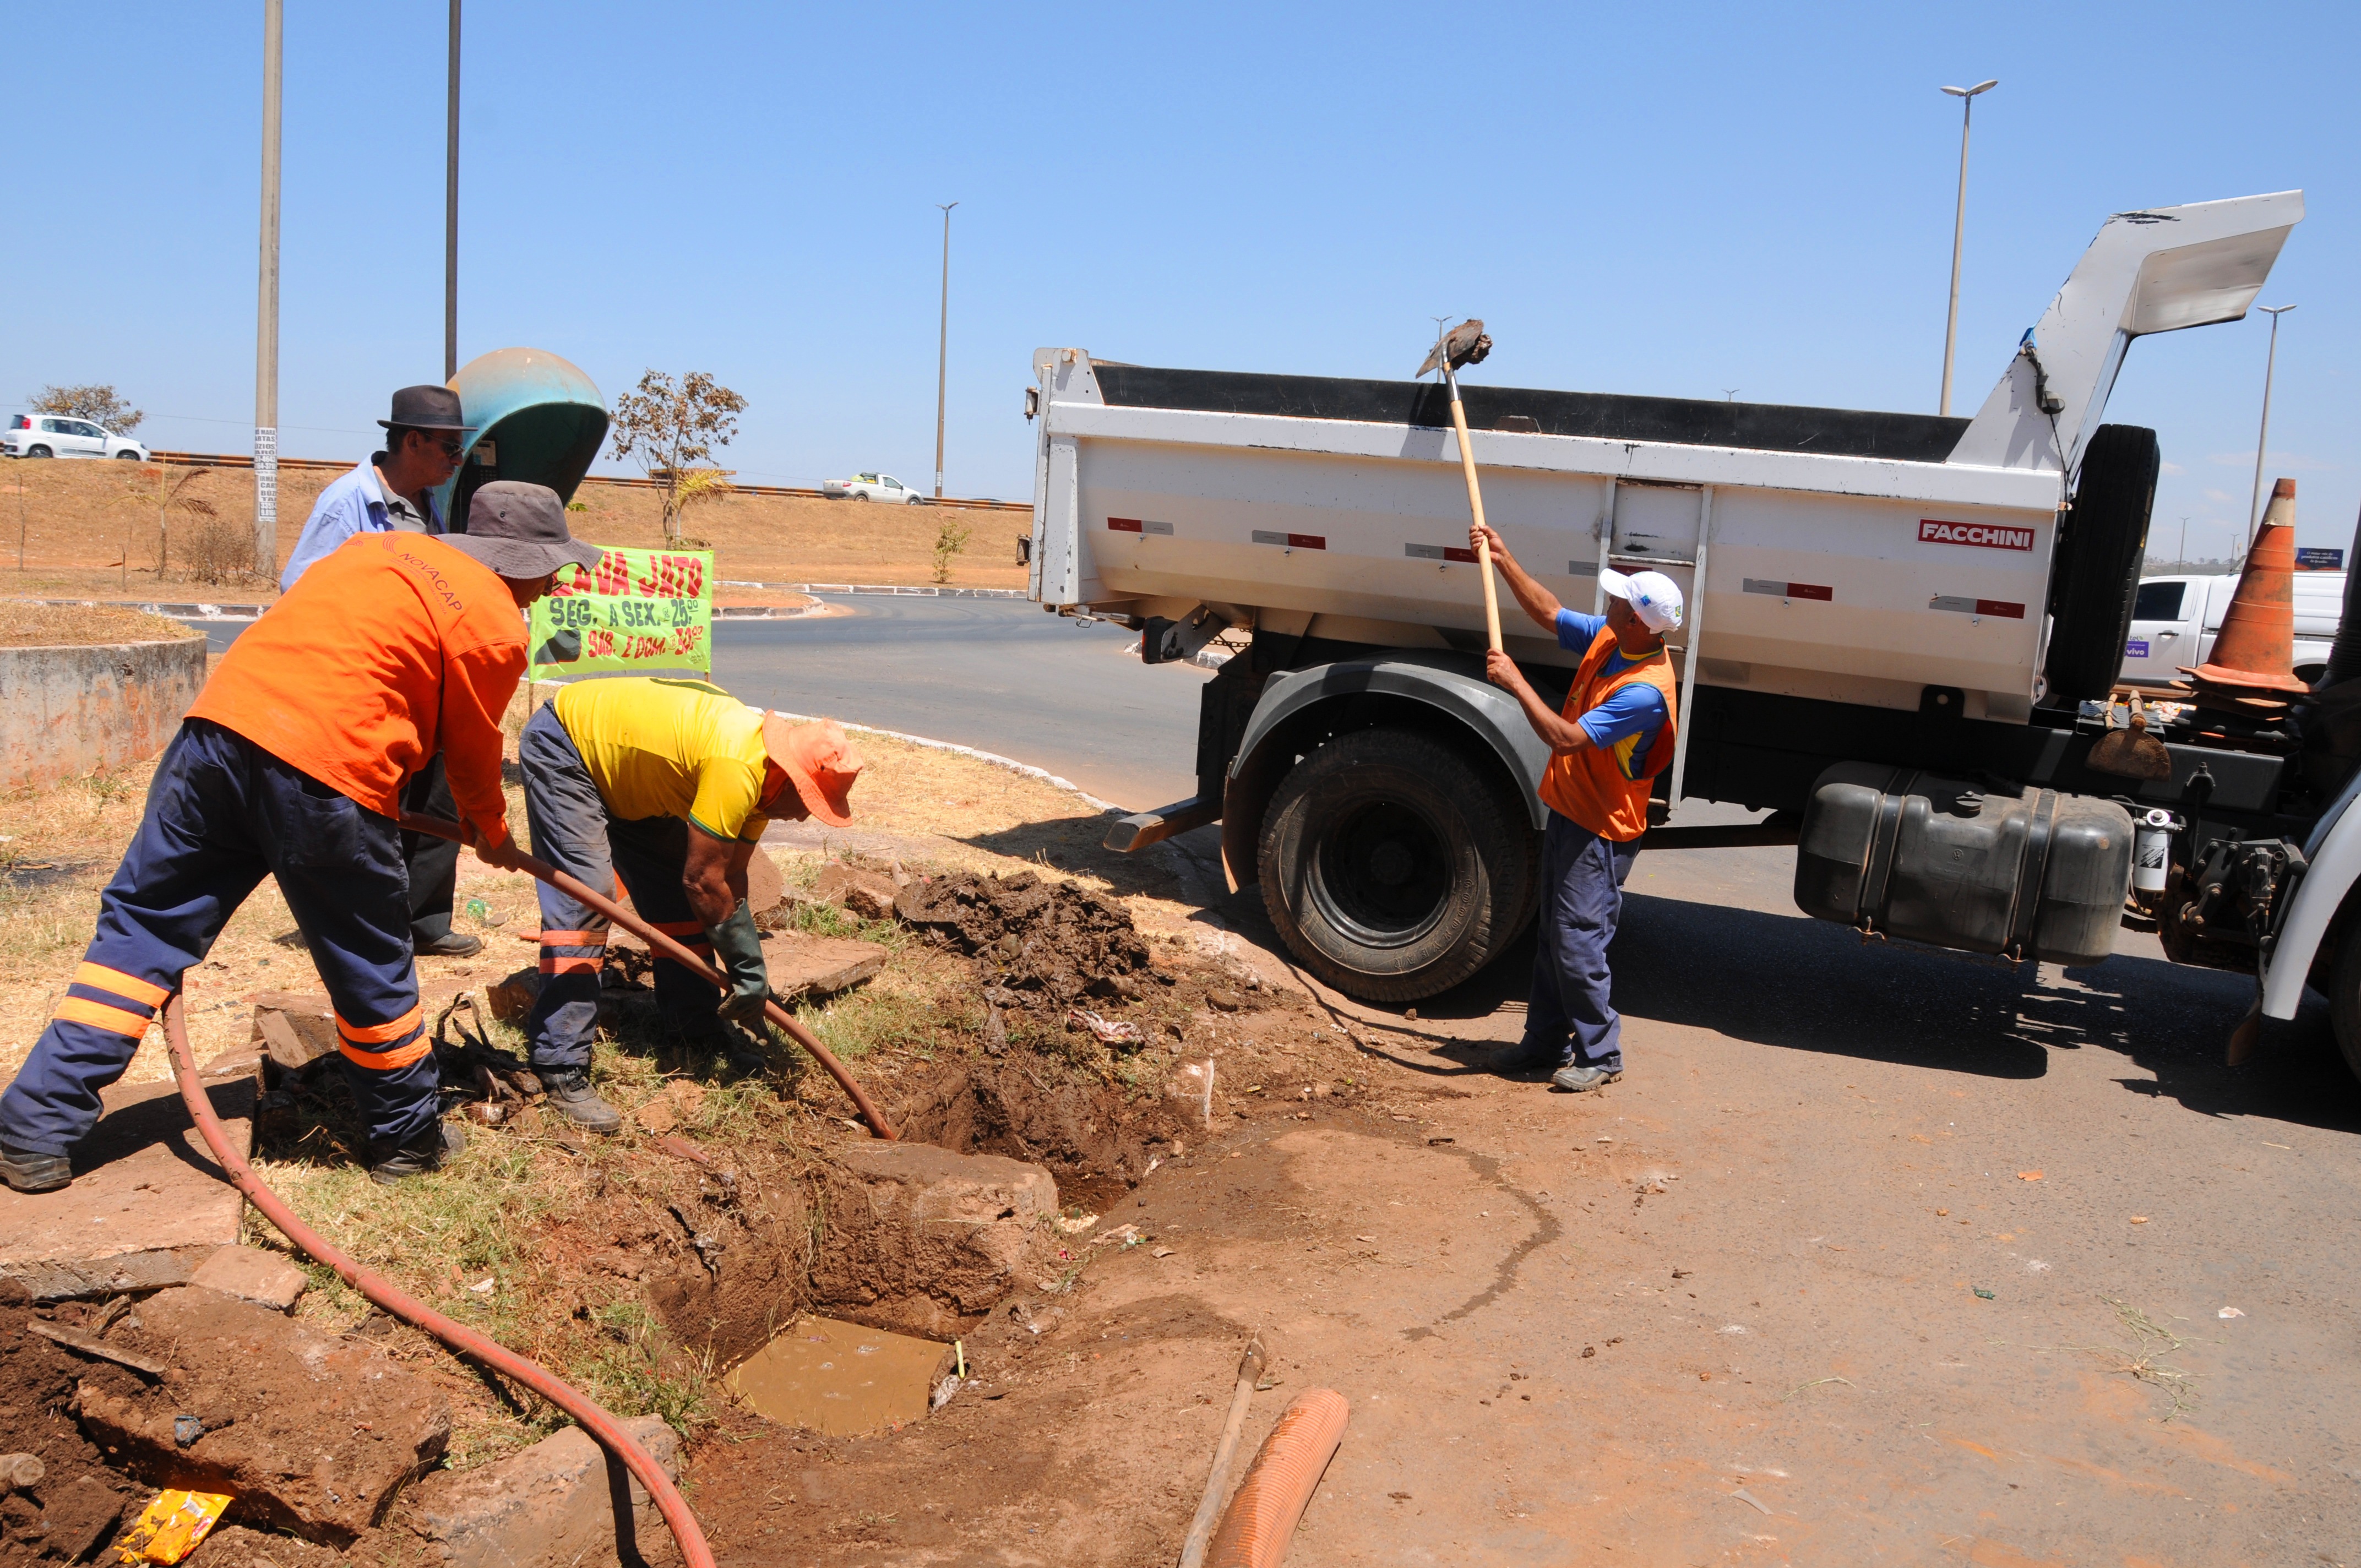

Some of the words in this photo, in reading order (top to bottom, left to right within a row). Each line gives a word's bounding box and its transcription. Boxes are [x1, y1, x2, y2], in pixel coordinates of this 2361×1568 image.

[1922, 523, 2031, 547] FACCHINI
[399, 553, 462, 610] NOVACAP
[638, 554, 703, 599] JATO
[550, 597, 597, 627] SEG.
[609, 603, 619, 627] A
[622, 601, 661, 627] SEX.
[621, 635, 633, 657] E
[634, 636, 666, 659] DOM.
